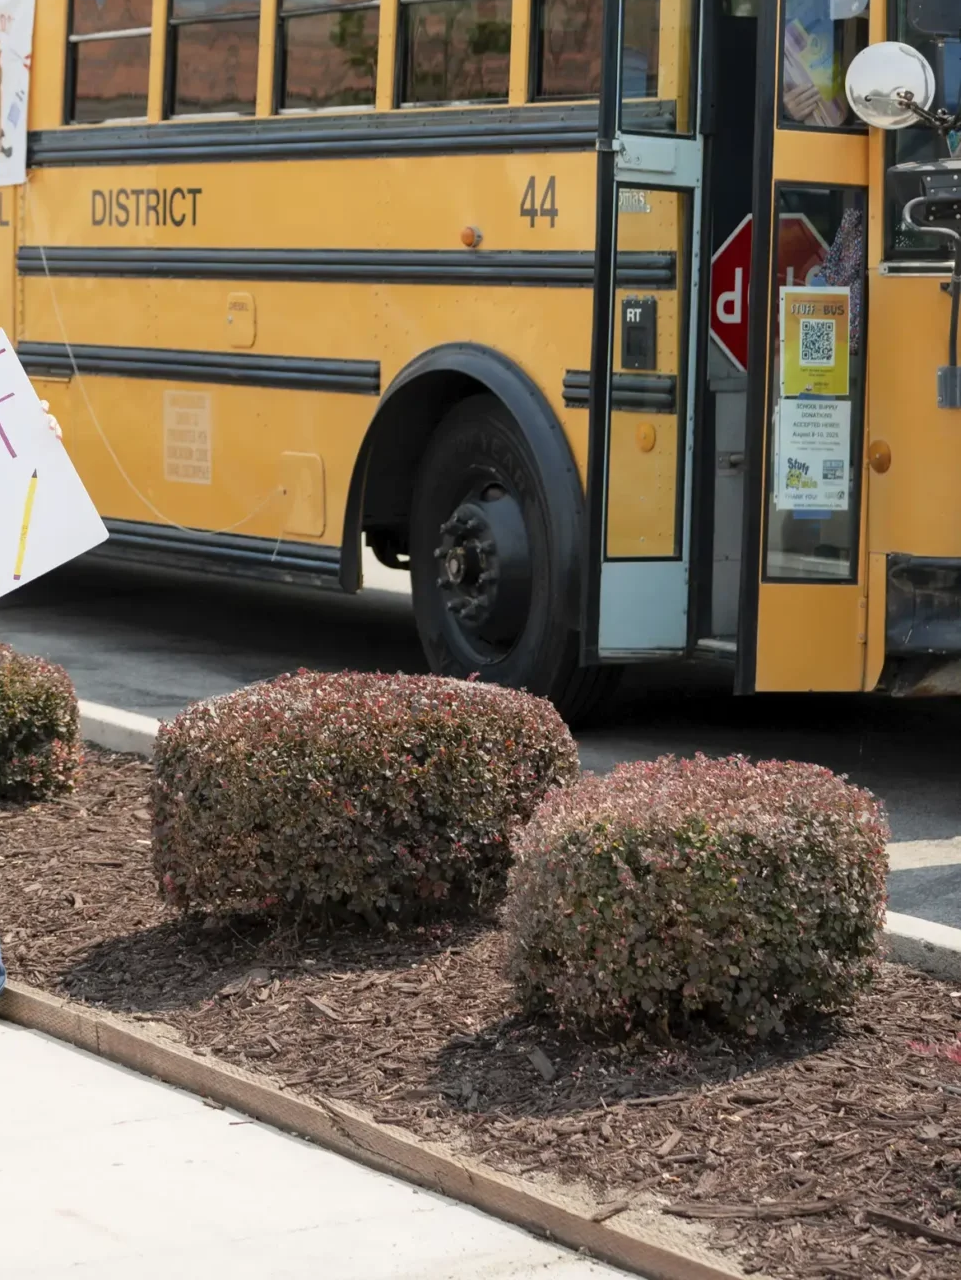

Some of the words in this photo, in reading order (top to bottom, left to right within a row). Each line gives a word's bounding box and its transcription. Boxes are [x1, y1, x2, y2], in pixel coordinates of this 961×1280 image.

[519, 175, 558, 228] 44
[618, 188, 645, 206] omas
[92, 187, 203, 227] DISTRICT
[626, 308, 642, 322] RT
[823, 305, 845, 316] BUS
